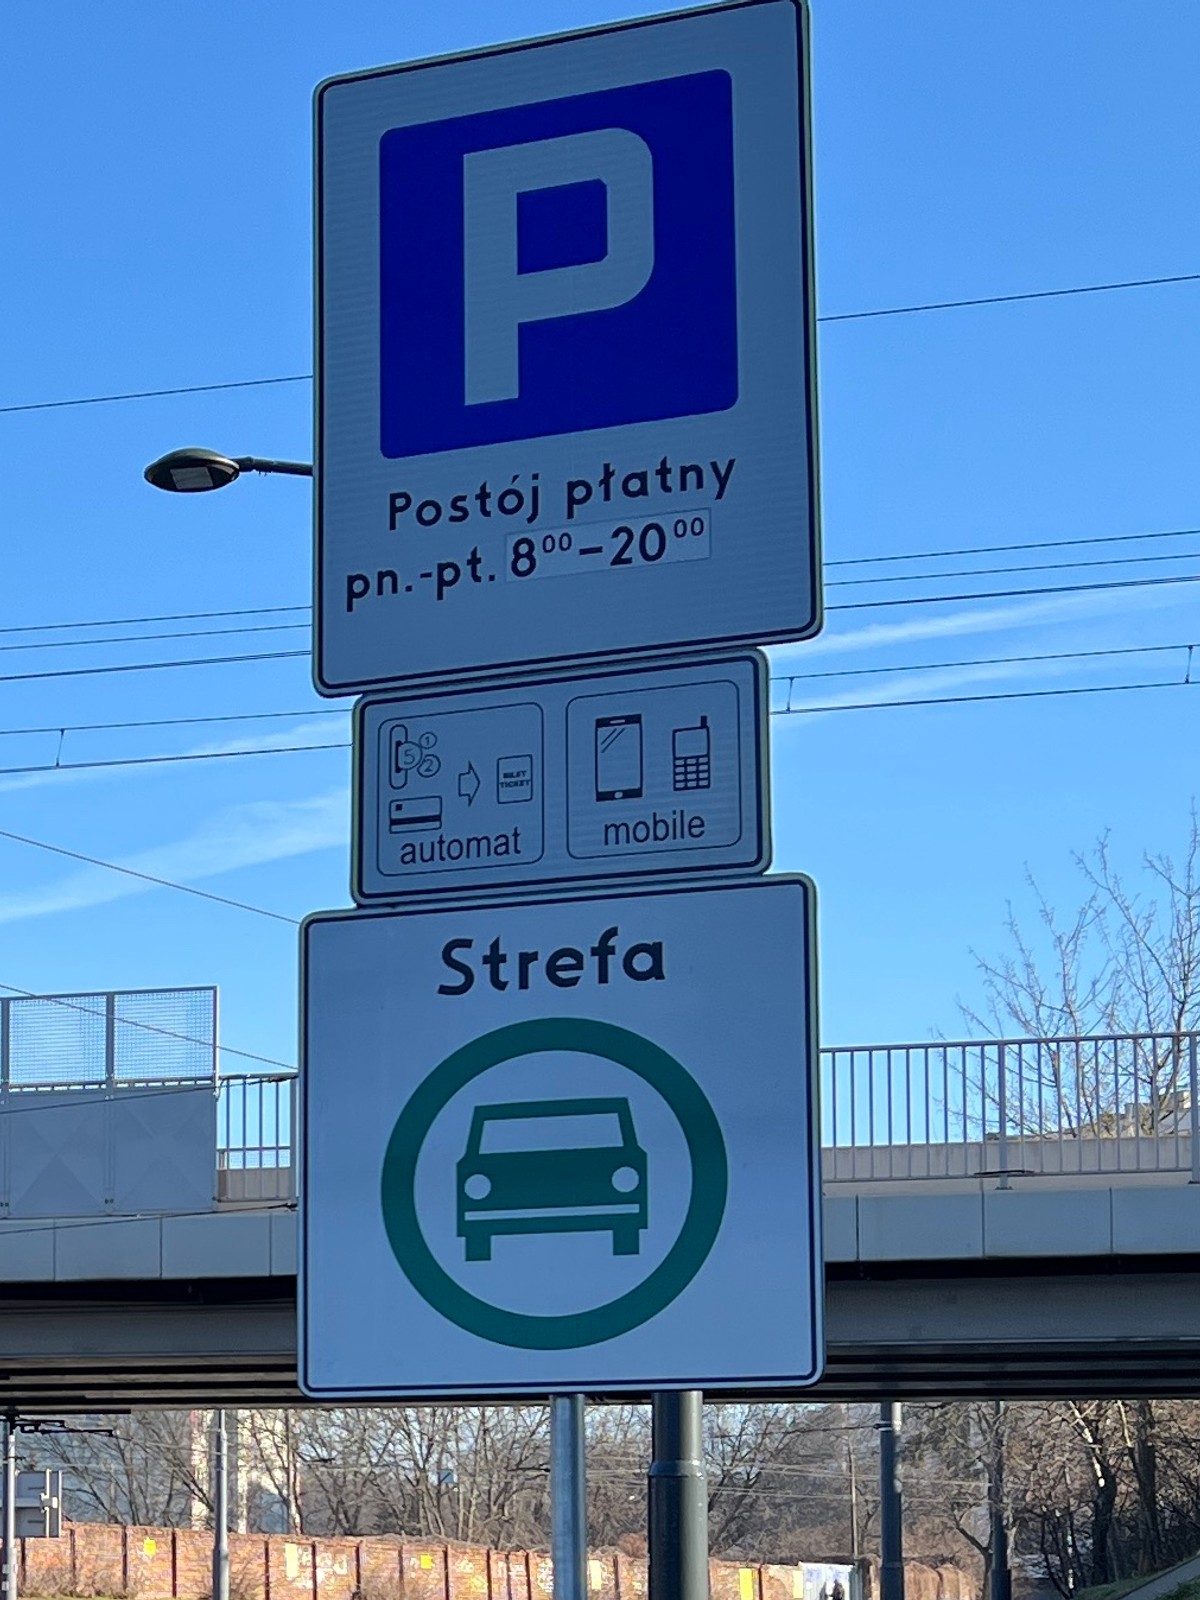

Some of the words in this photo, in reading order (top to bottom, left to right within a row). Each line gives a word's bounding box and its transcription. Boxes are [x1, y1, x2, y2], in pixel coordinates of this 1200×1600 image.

[462, 126, 655, 407] P
[388, 474, 541, 531] Postój
[566, 456, 736, 519] płatny
[346, 545, 497, 612] pn.-pt.
[400, 827, 521, 864] automat
[603, 810, 706, 847] mobile
[437, 926, 666, 996] Strefa
